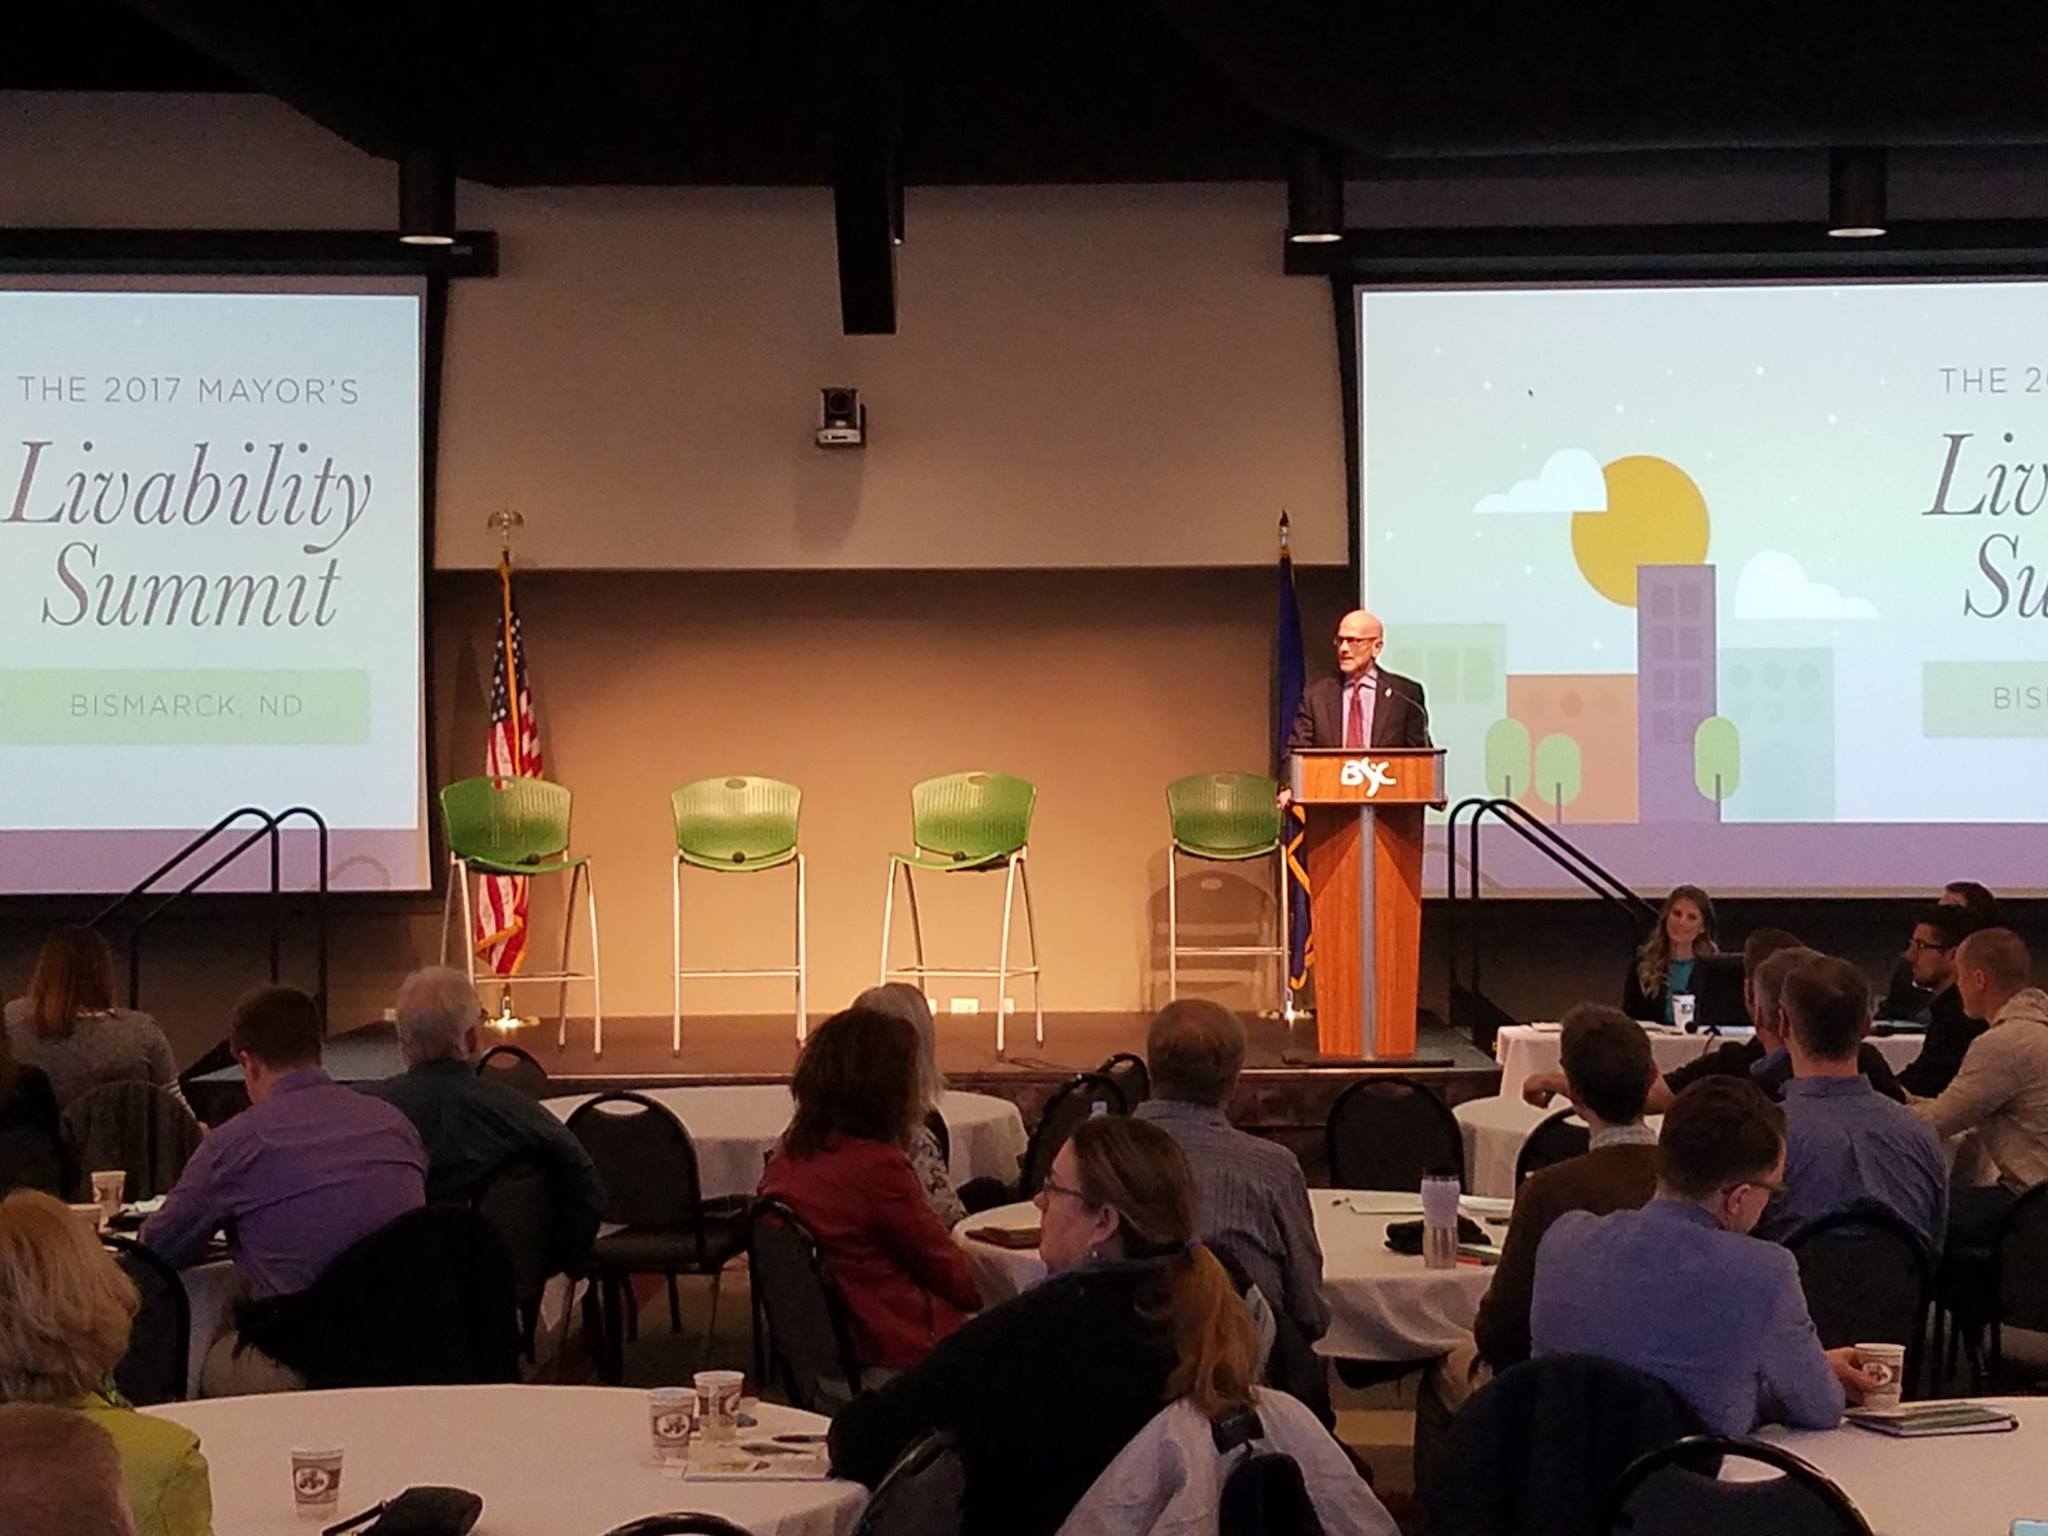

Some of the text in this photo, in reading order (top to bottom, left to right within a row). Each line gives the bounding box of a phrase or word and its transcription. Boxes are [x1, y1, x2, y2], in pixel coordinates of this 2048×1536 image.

[17, 375, 360, 405] THE 2017 MAYOR'S
[1938, 366, 2048, 394] THE 2
[0, 440, 372, 554] Livability
[1921, 431, 2048, 517] Liv
[41, 541, 342, 627] Summit
[1963, 533, 2048, 619] Su
[70, 694, 303, 721] BISMARCK, ND
[1993, 686, 2048, 710] BIS
